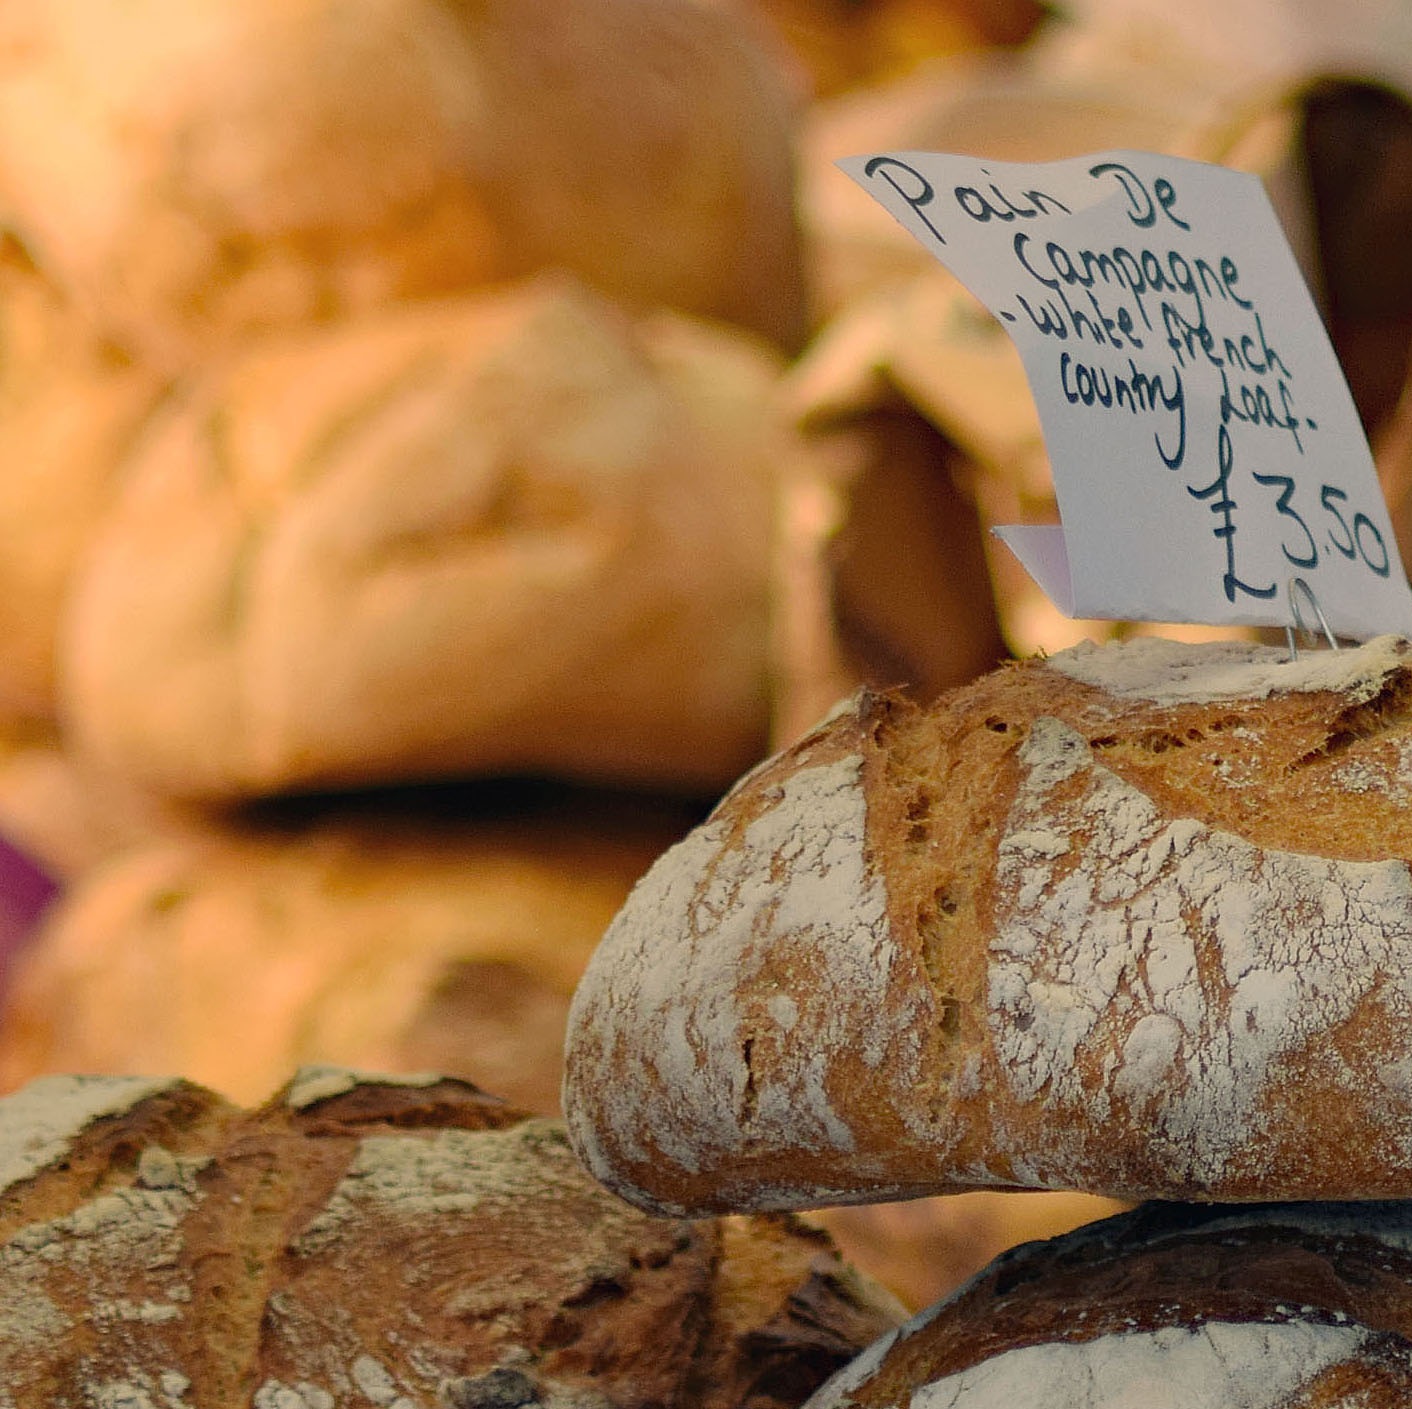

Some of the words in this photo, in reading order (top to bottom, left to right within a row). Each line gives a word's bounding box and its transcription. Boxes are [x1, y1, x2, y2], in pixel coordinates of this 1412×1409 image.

[865, 156, 1073, 246] Pain
[1089, 162, 1191, 231] De
[1187, 424, 1391, 603] £3.50
